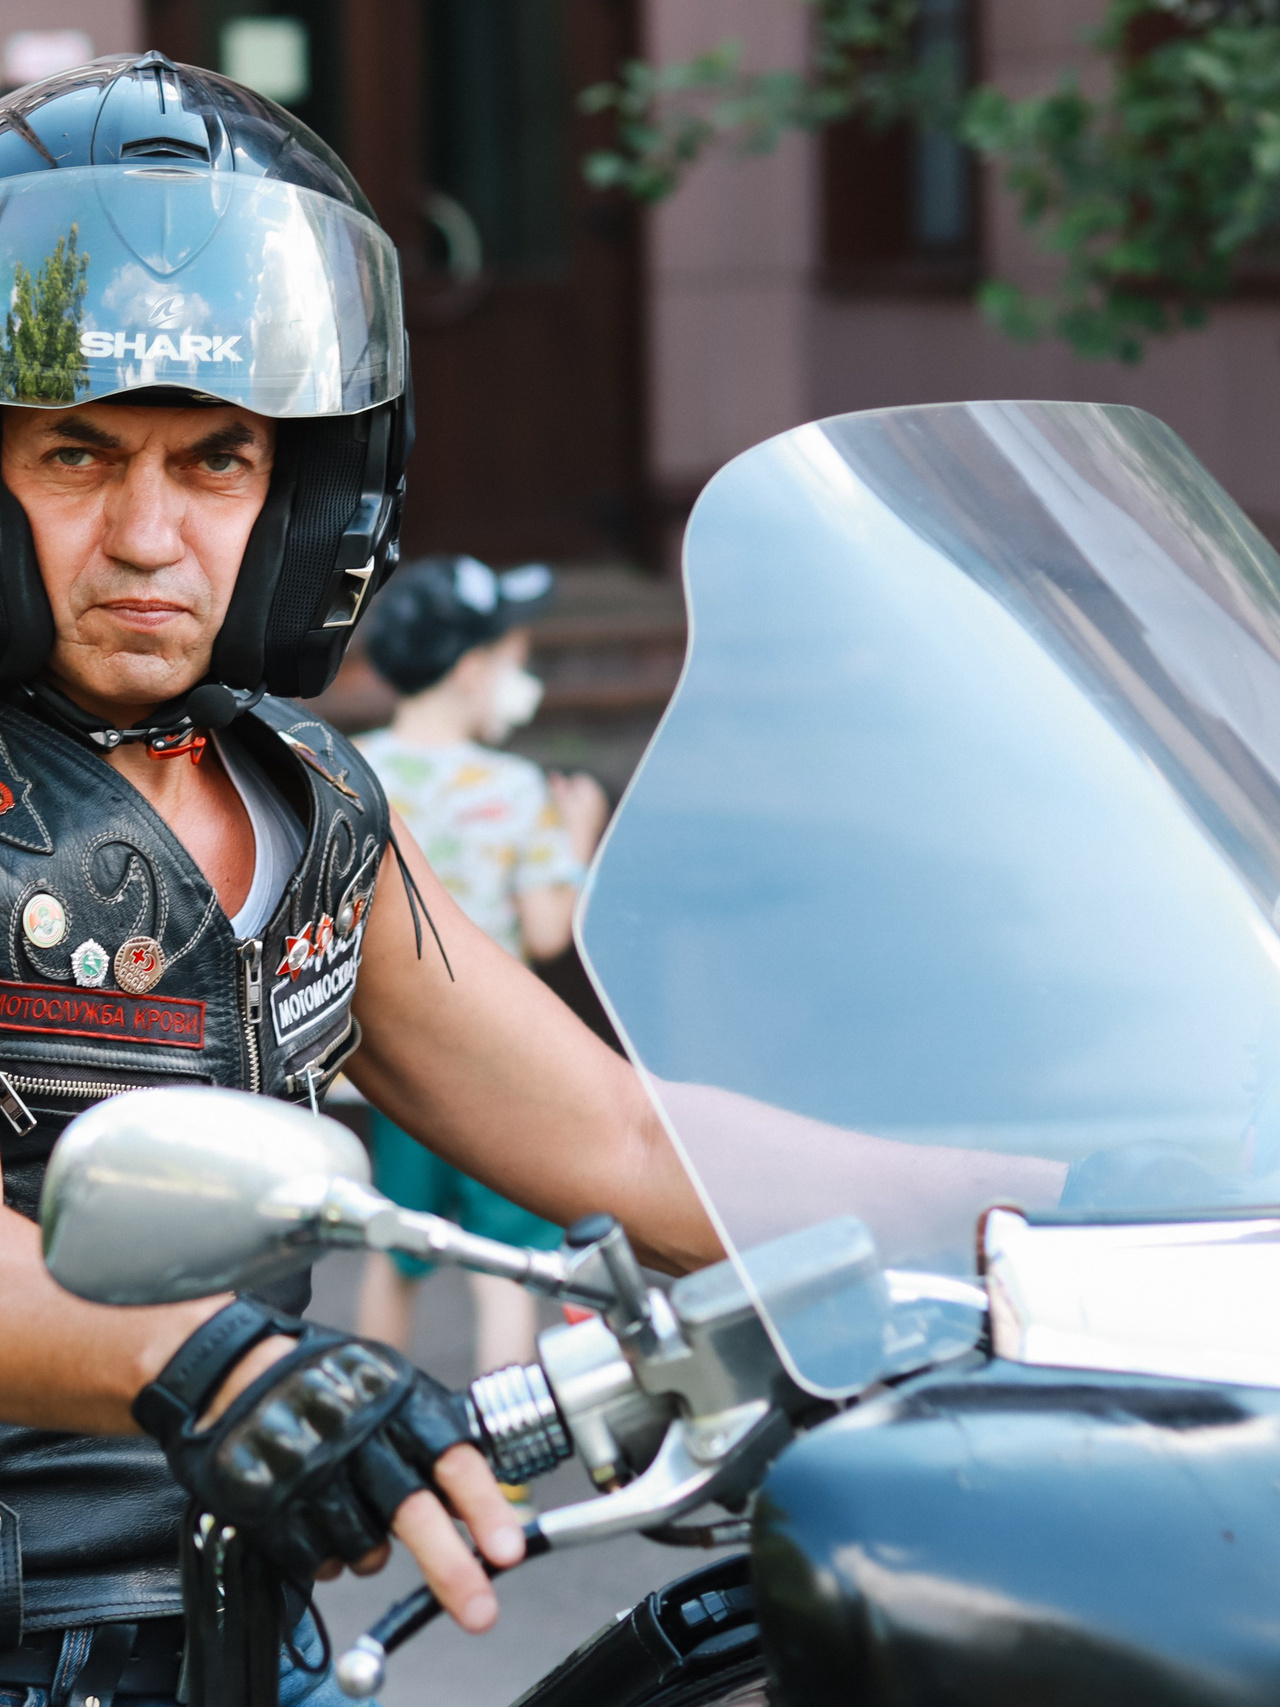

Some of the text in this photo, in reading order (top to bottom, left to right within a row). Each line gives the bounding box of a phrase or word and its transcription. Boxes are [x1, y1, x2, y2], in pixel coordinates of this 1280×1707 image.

[80, 331, 243, 362] SHARK
[119, 967, 146, 990] СССР
[134, 1006, 199, 1036] КРОВИ
